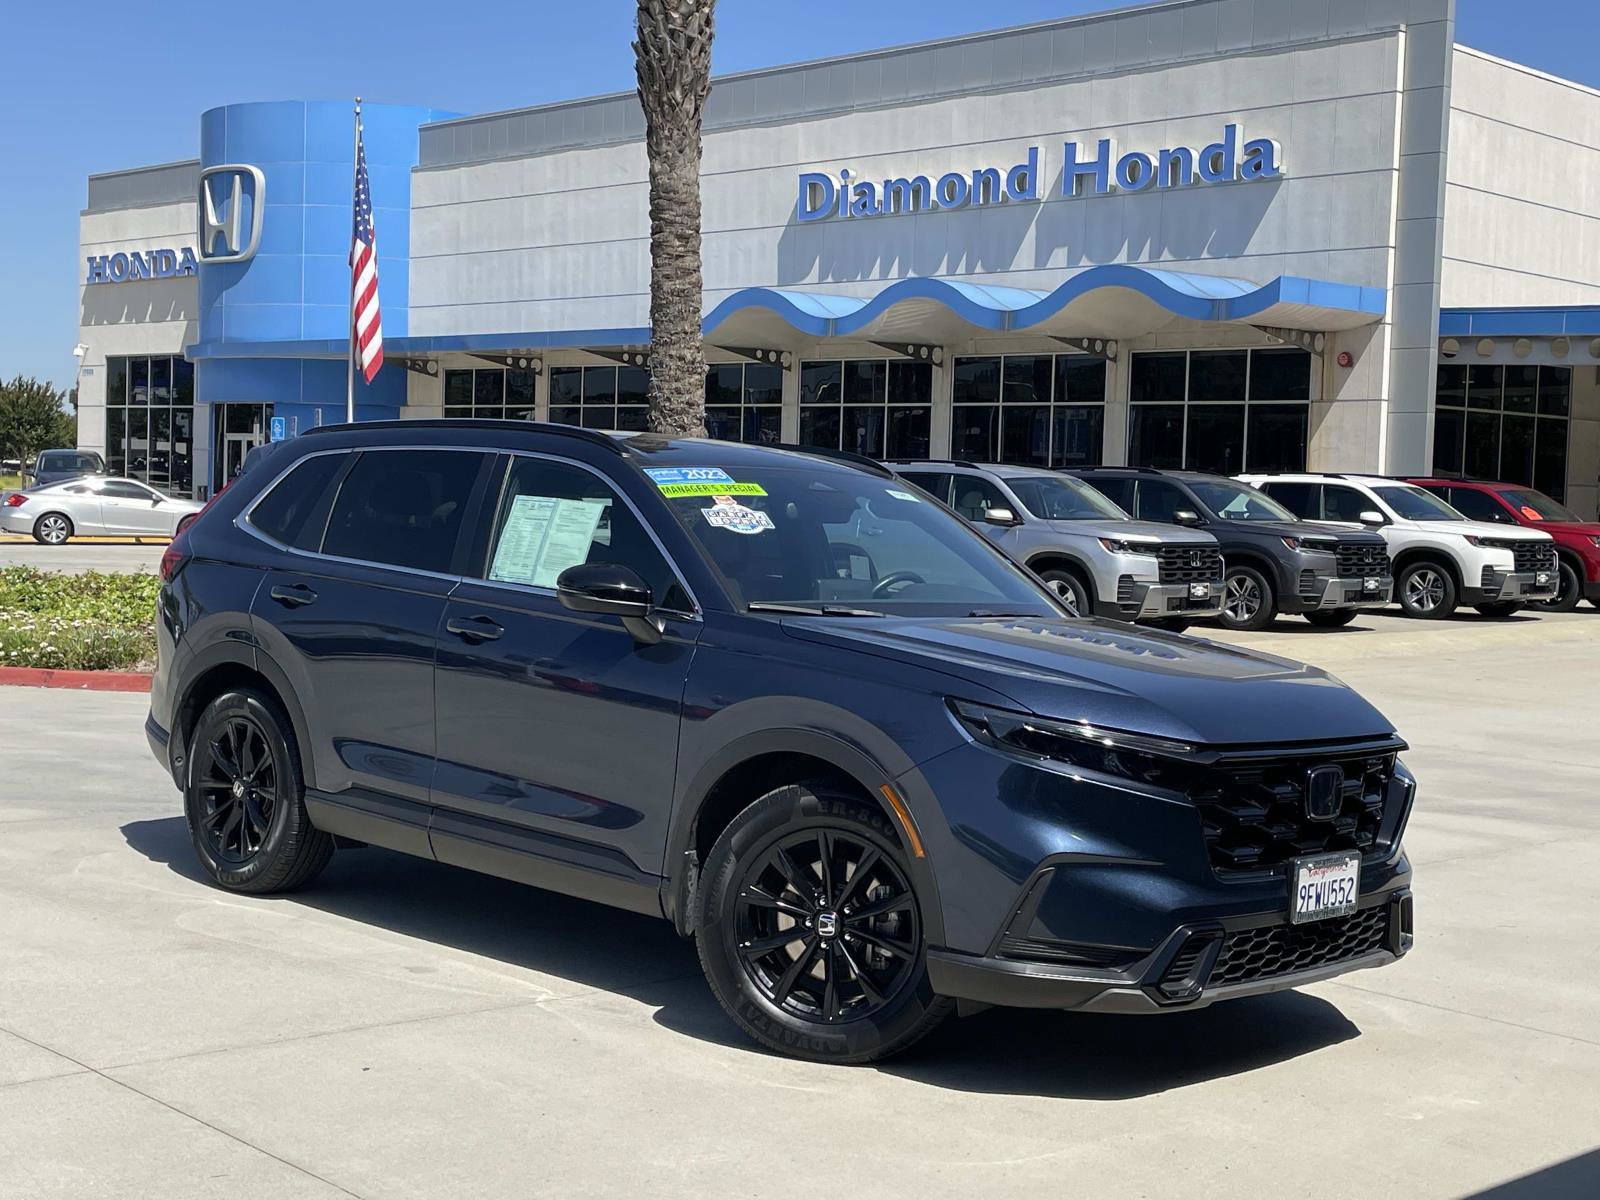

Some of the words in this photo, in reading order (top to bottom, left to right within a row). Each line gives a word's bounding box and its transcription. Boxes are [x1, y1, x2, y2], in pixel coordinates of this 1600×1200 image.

[798, 146, 1044, 222] Diamond
[1062, 122, 1282, 197] Honda
[87, 247, 198, 284] HONDA
[661, 484, 718, 495] MANAGER'S
[723, 484, 760, 493] SPECIAL
[681, 469, 727, 480] 2023
[1299, 877, 1354, 912] 9FWU552
